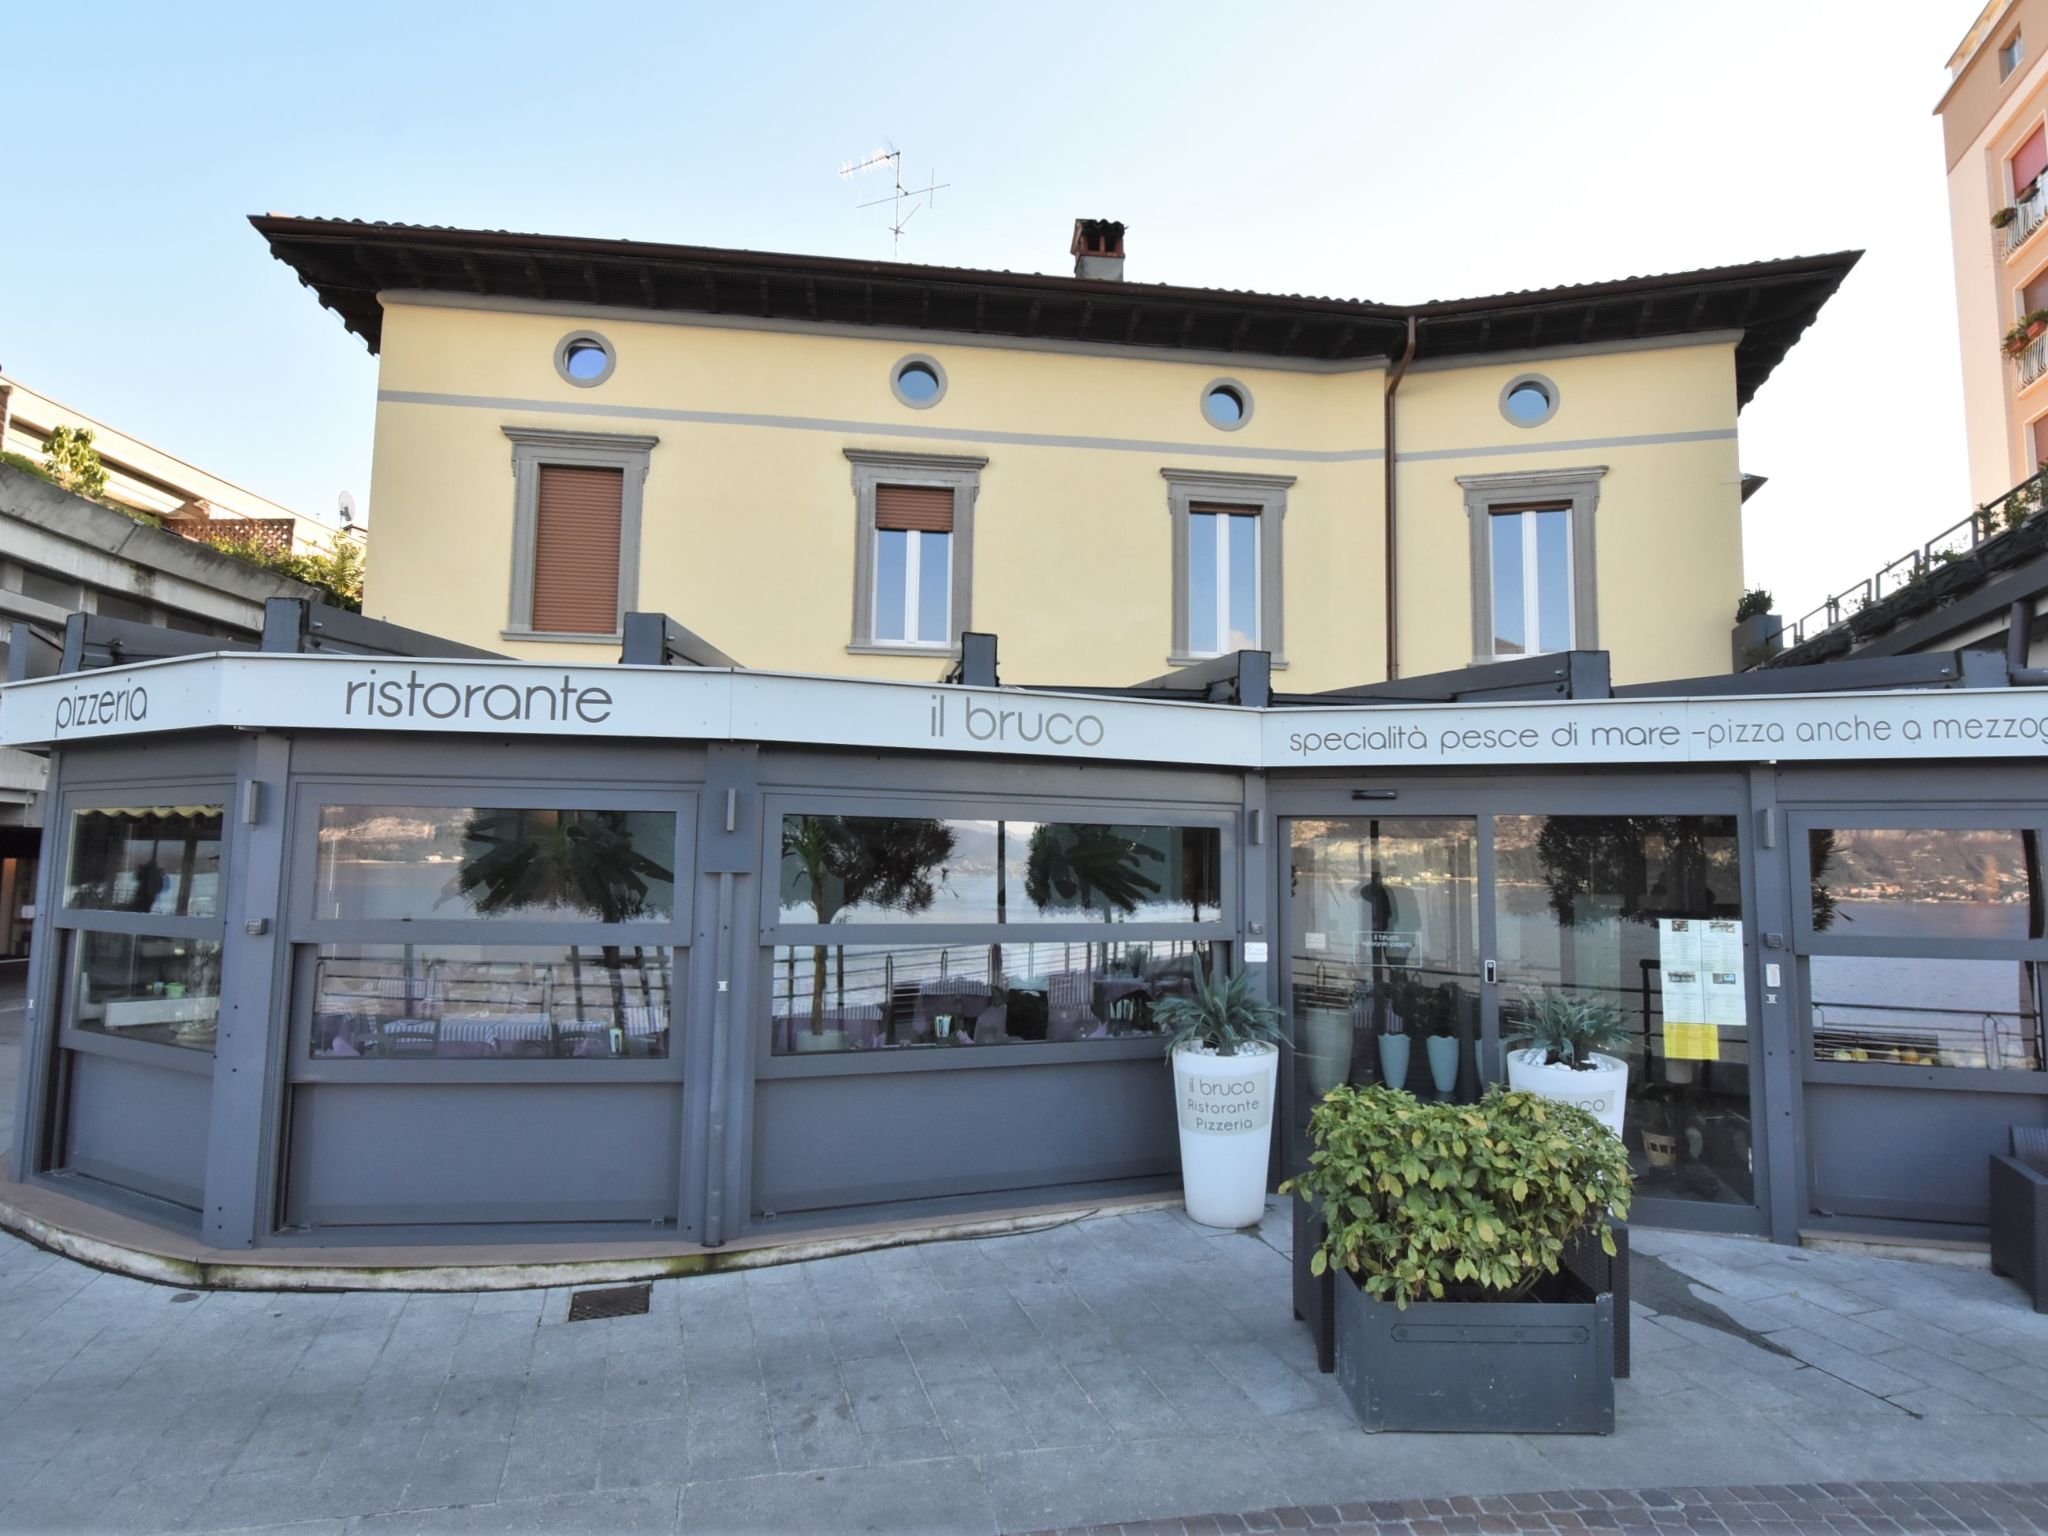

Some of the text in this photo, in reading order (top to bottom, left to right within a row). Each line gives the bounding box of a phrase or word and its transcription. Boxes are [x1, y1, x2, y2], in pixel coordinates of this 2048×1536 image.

[54, 677, 148, 739] pizzeria
[345, 669, 613, 724] ristorante
[930, 694, 1105, 747] il bruco
[1289, 724, 1428, 757] specialità
[1440, 728, 1539, 755] pesce
[1551, 721, 1578, 747] di
[1591, 725, 1681, 746] mare
[1796, 715, 1893, 743] anche
[1902, 719, 1922, 741] a
[1187, 1098, 1260, 1115] Ristorante
[1199, 1079, 1256, 1097] bruco
[1196, 1116, 1254, 1132] Pizzeria
